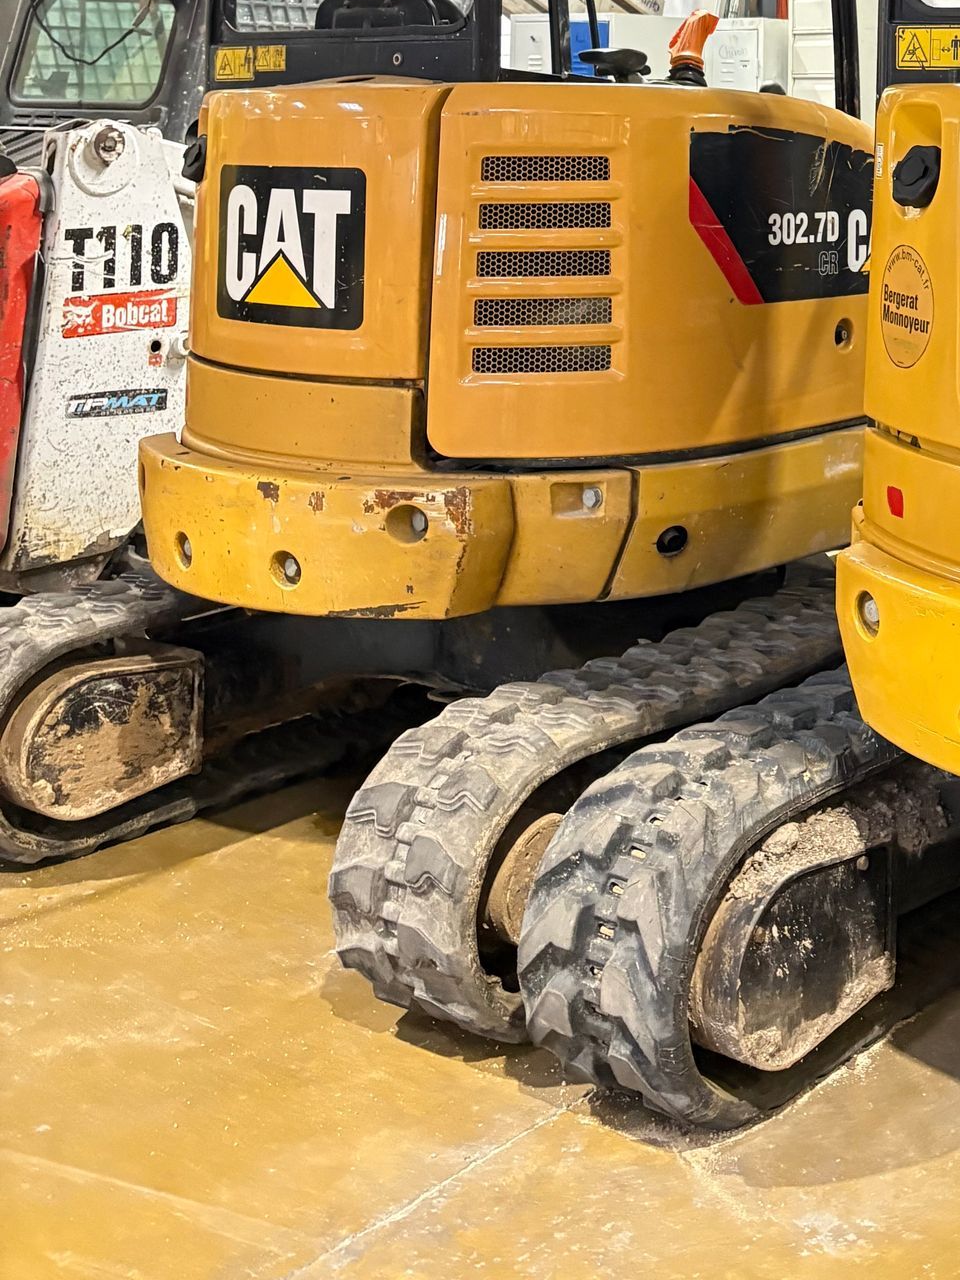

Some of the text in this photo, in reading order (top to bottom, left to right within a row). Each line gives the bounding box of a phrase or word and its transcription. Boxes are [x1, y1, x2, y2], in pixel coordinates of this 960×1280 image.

[768, 211, 840, 246] 302.7D
[64, 222, 179, 292] T110
[225, 184, 351, 309] CAT
[818, 250, 839, 276] CR
[883, 283, 919, 311] Bergerat
[101, 300, 169, 328] Bobcat
[882, 303, 930, 334] Monnoyeur
